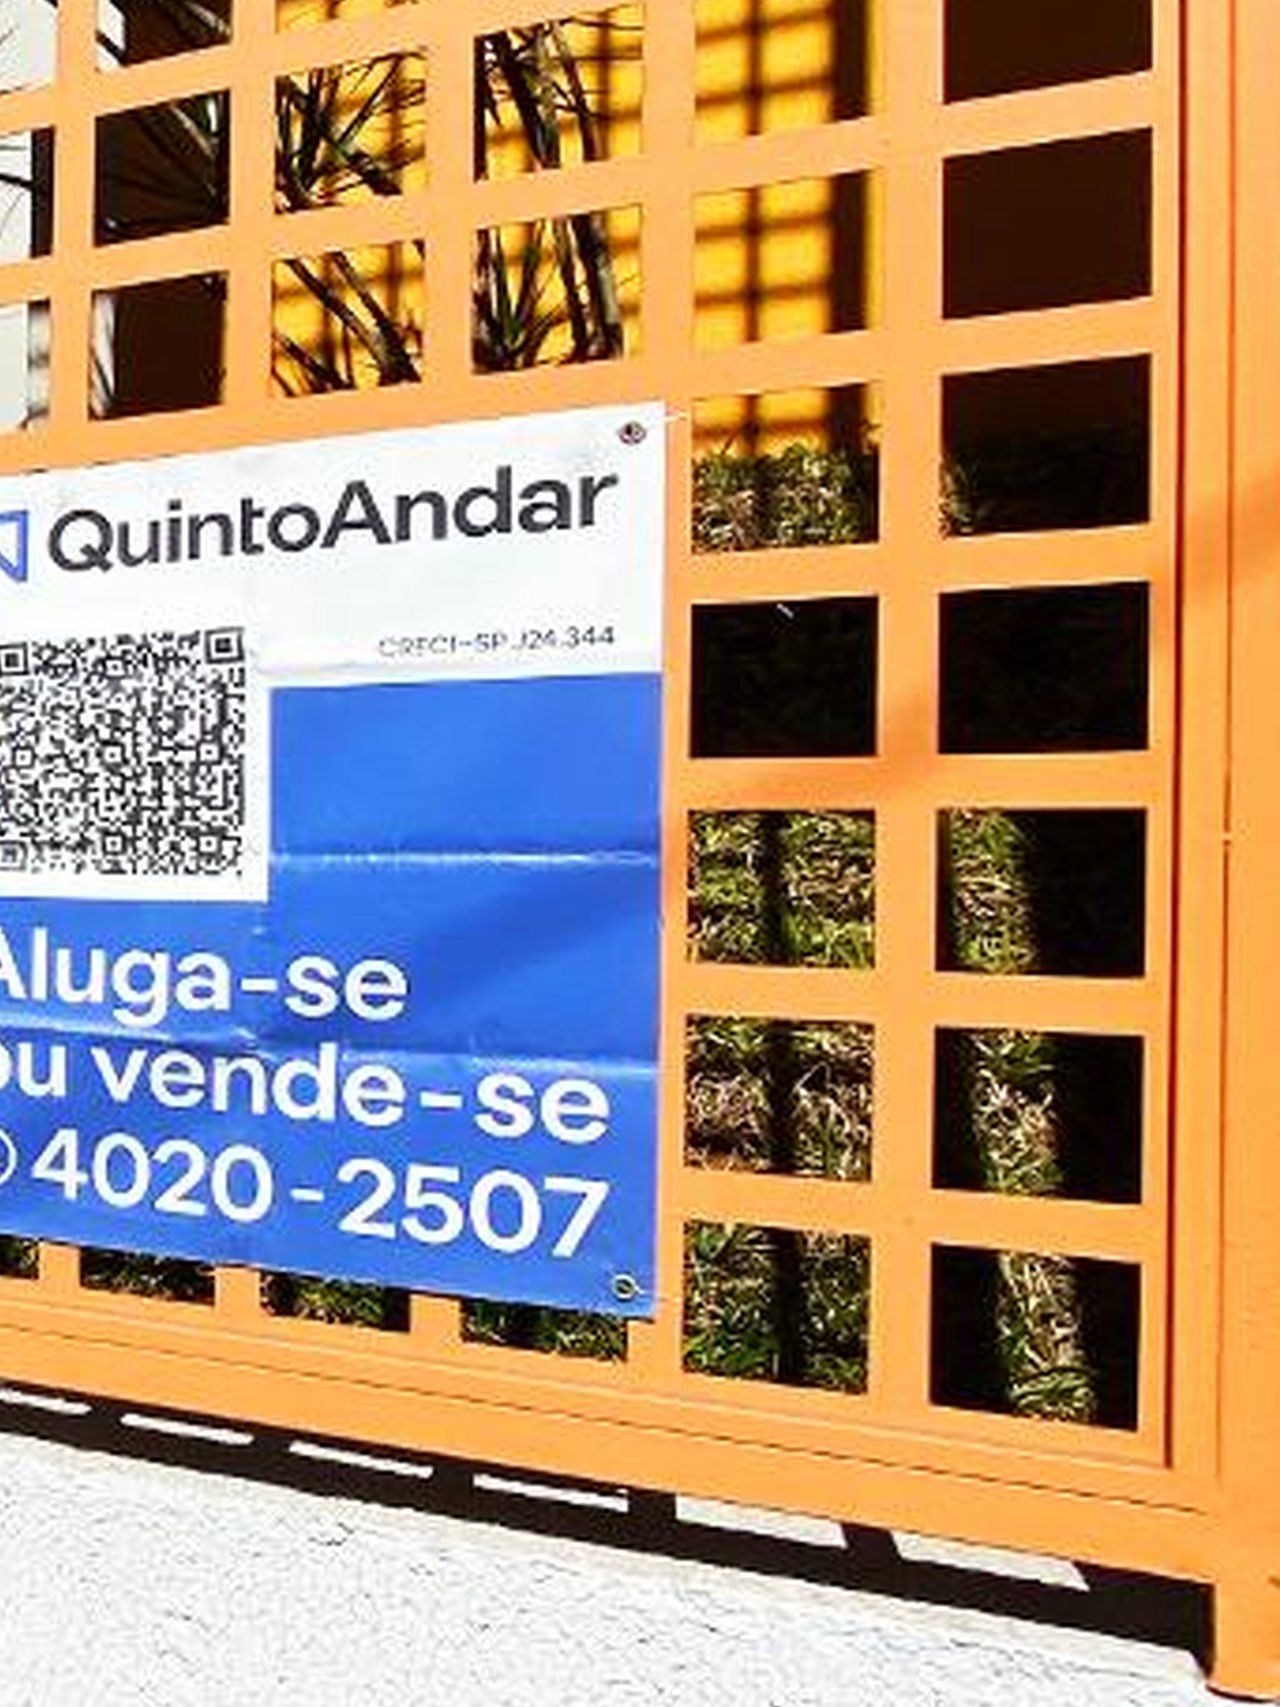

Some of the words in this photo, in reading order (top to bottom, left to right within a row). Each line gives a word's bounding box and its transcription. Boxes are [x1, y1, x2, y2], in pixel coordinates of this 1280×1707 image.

[46, 464, 621, 575] QuintoAndar
[89, 1041, 611, 1145] vende-se
[31, 1127, 611, 1260] 4020-2507
